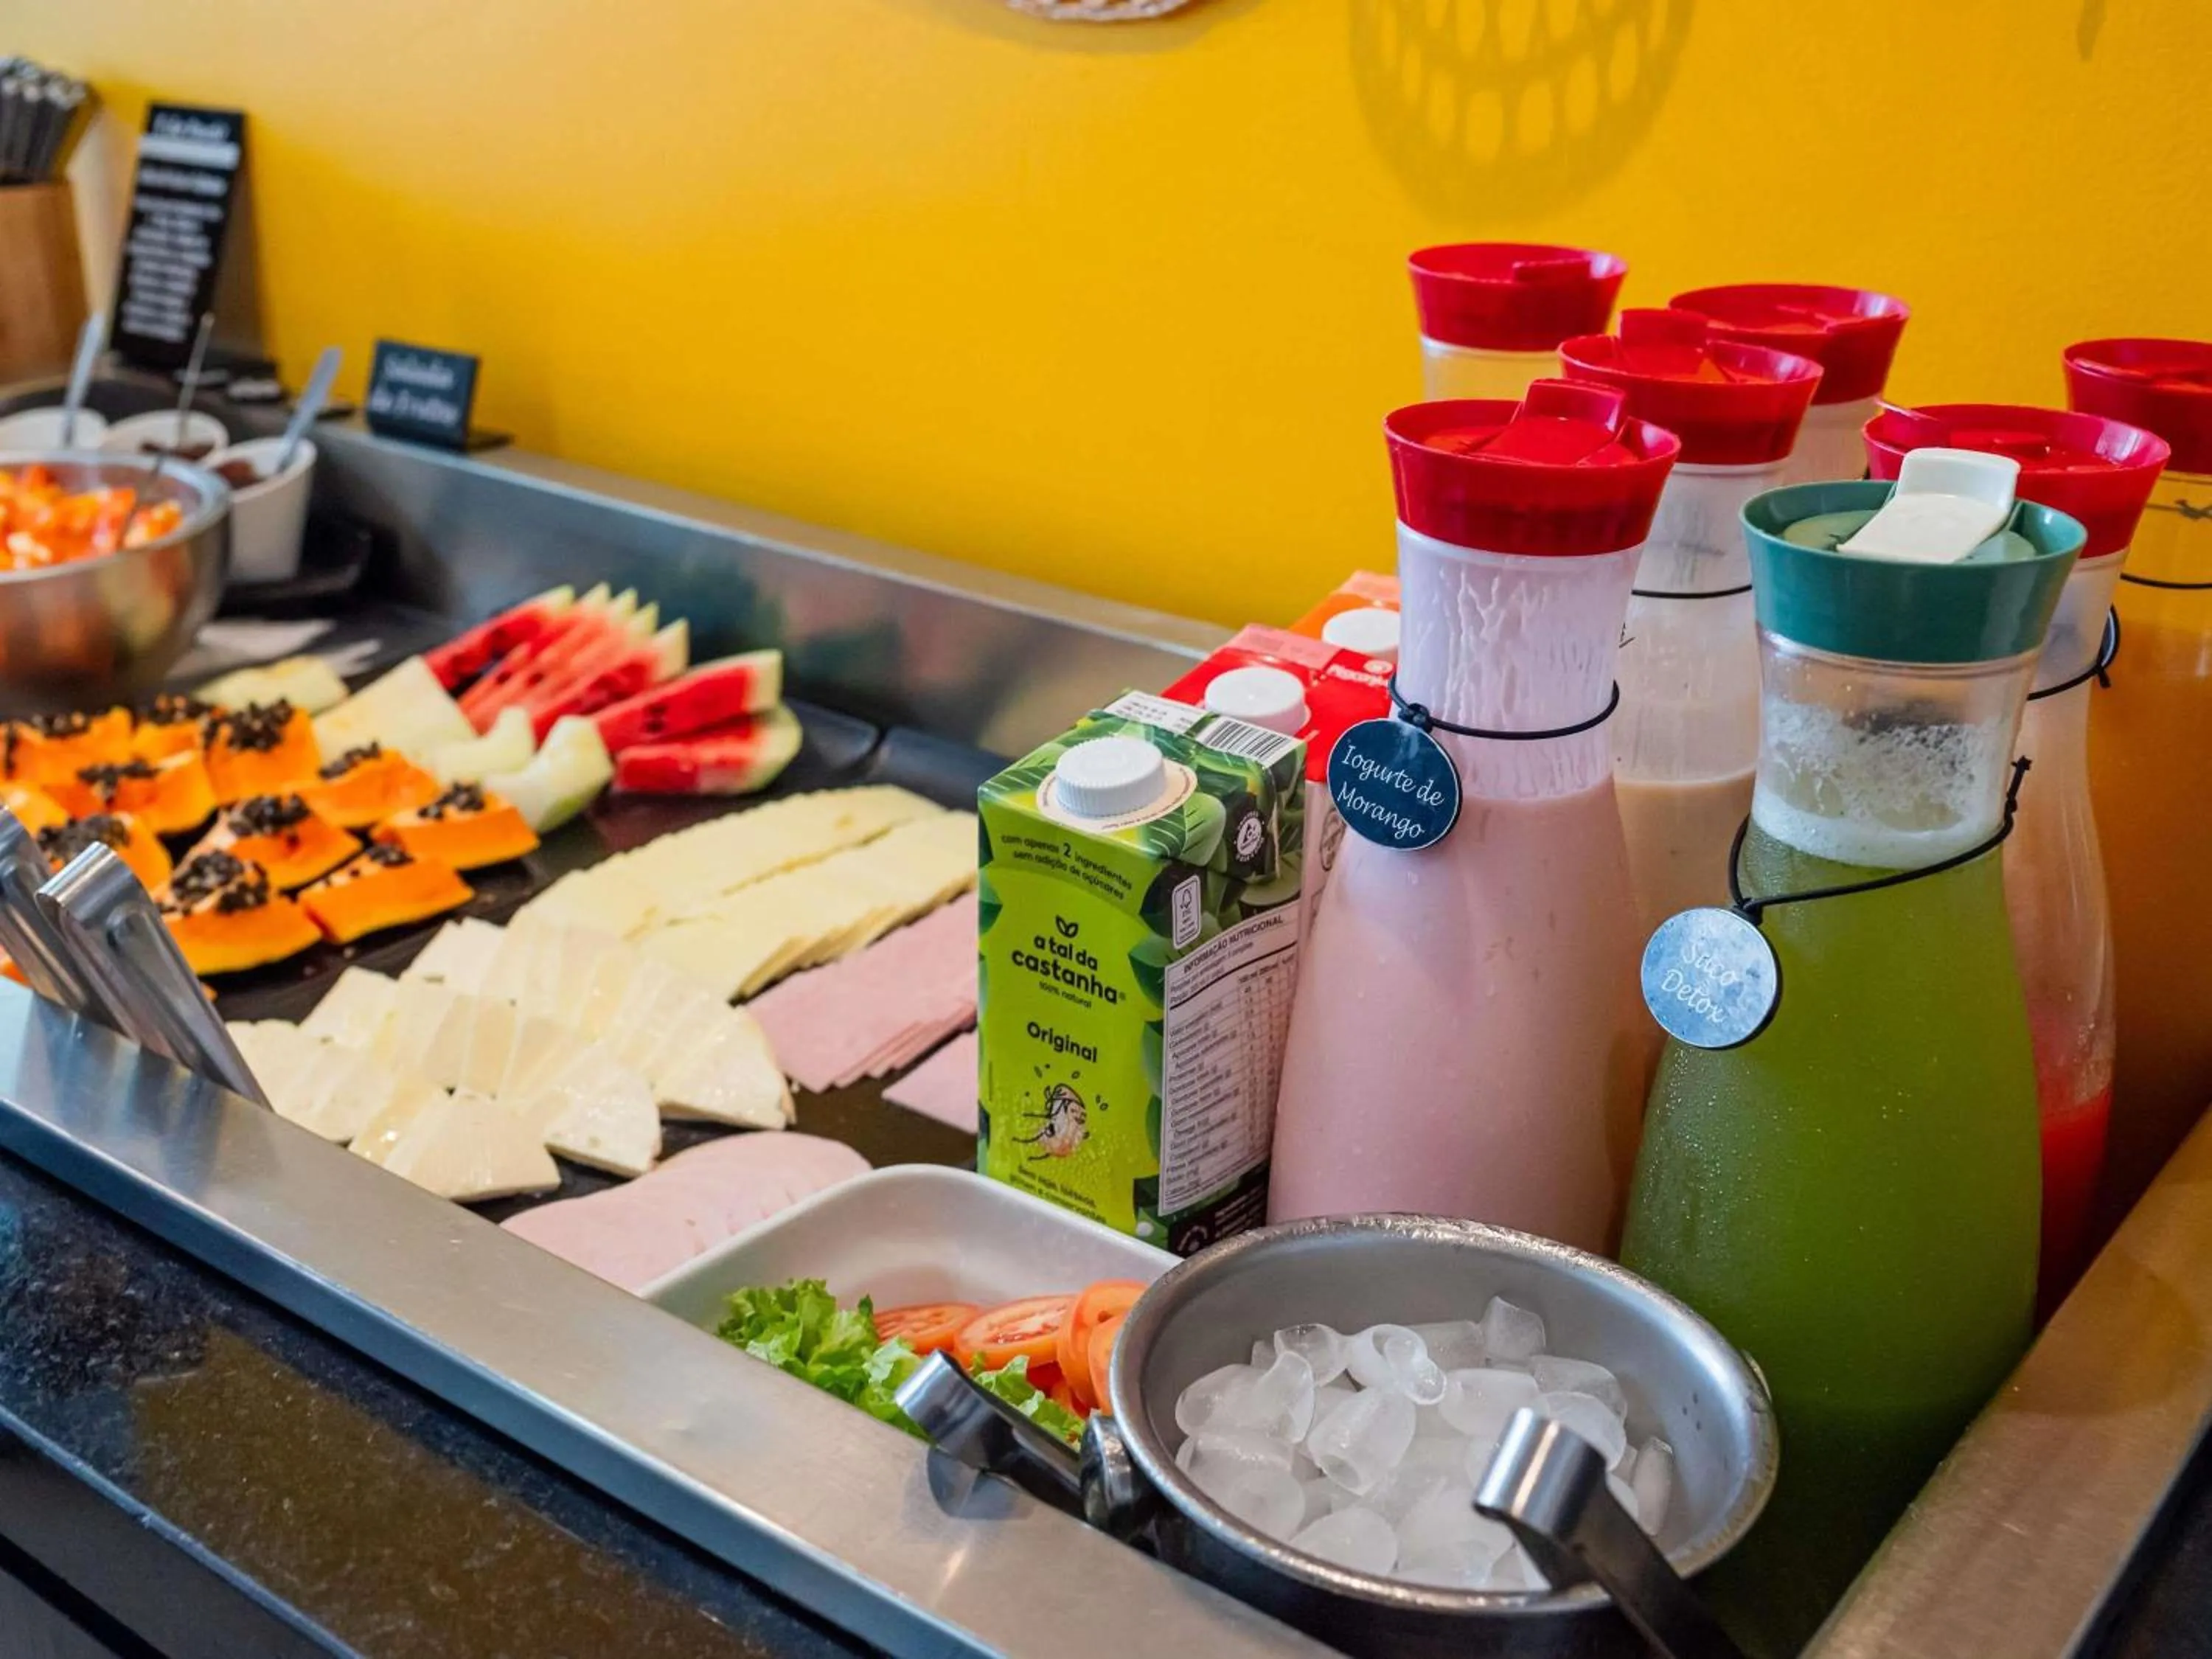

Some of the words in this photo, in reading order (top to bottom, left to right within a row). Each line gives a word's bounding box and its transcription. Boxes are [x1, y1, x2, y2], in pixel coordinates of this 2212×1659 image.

[1340, 744, 1415, 793] Iogurte
[1416, 778, 1446, 807] de
[1337, 781, 1425, 840] Morango
[1001, 834, 1023, 844] com
[1024, 838, 1060, 853] apenas
[1062, 842, 1071, 858] 2
[1074, 851, 1133, 890] ingredientes
[1012, 850, 1032, 861] sem
[1070, 863, 1081, 877] de
[1034, 934, 1046, 950] a
[1048, 936, 1074, 960] tal
[1076, 949, 1099, 972] da
[1183, 938, 1228, 974] INFORMAÇÃO
[1228, 914, 1284, 945] NUTRICIONAL
[1012, 950, 1119, 1006] castanha
[1660, 968, 1730, 1024] Detox
[1026, 1020, 1098, 1063] Original
